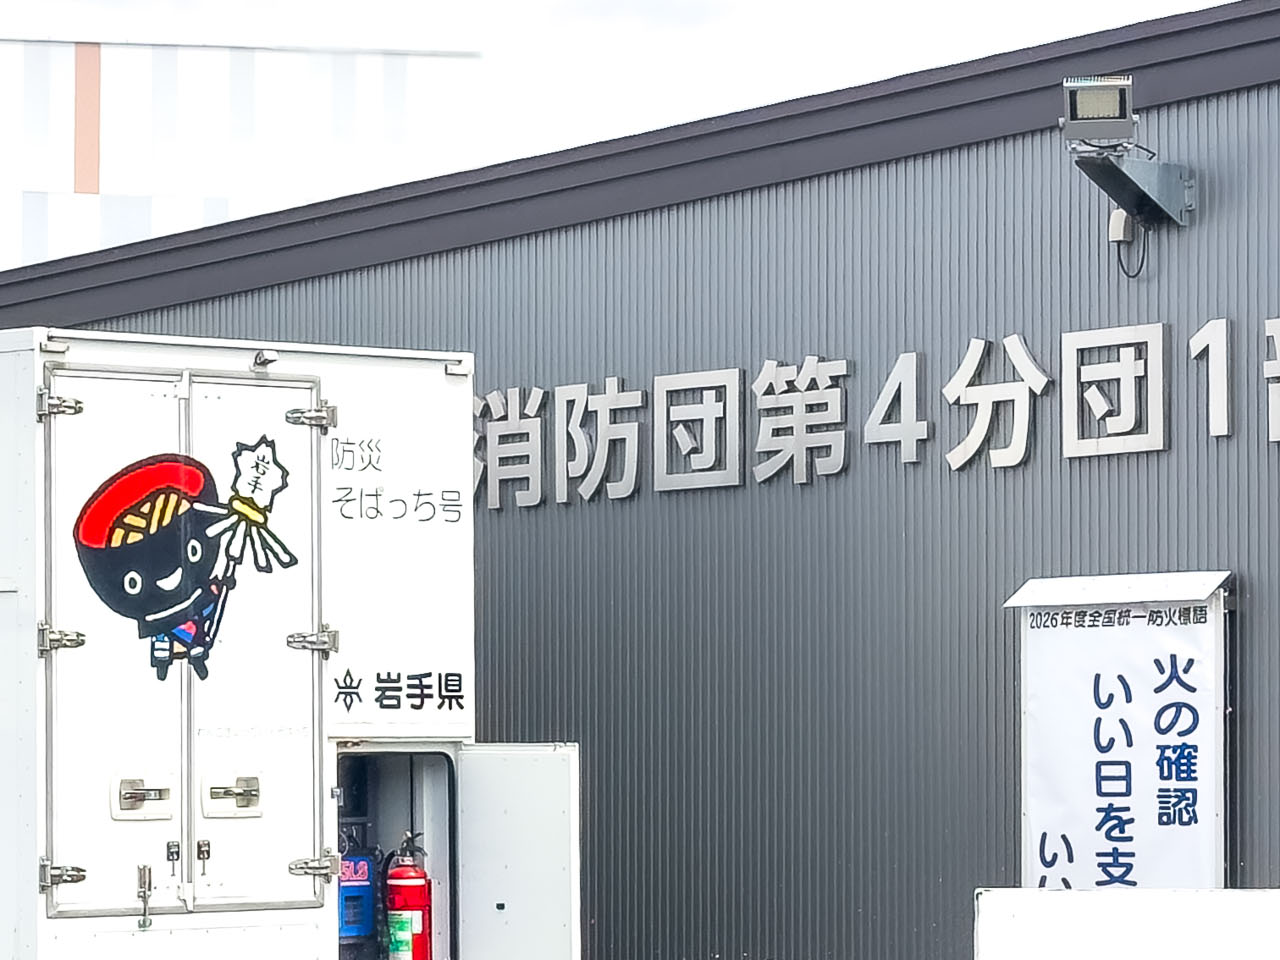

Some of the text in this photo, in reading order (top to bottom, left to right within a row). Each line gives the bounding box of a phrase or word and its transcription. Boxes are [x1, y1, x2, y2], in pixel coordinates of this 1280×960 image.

[474, 317, 1280, 510] 消防団第4分団1
[247, 454, 270, 494] 岩手
[331, 437, 382, 471] 防災
[374, 671, 464, 711] 岩手県
[1153, 653, 1200, 826] 火の確認
[1093, 673, 1138, 887] いい日を支
[1039, 831, 1074, 889] い
